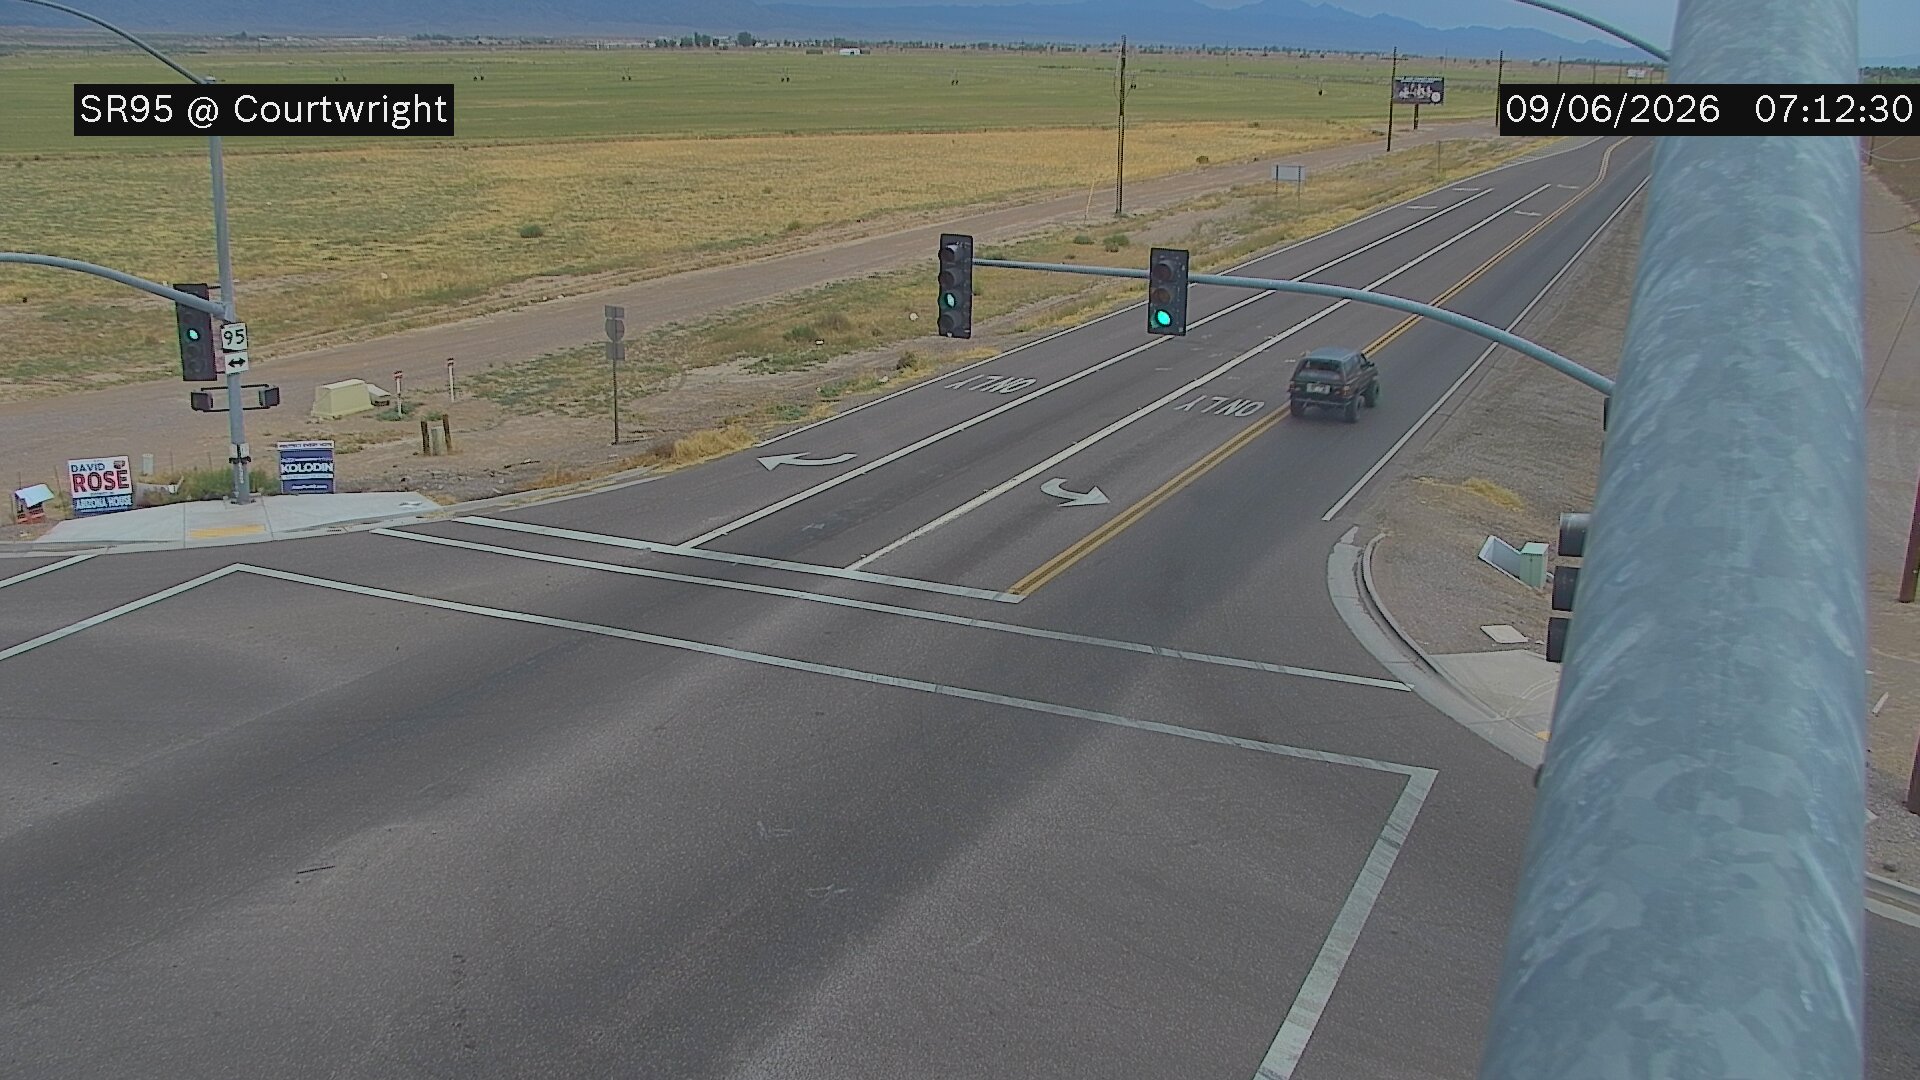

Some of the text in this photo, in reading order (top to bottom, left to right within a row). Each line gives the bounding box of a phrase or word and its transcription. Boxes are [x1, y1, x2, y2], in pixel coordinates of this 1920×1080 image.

[223, 328, 245, 346] 95
[944, 374, 1036, 394] ONLY
[1173, 395, 1265, 417] ONLY
[70, 463, 105, 473] DAVID
[280, 462, 333, 474] KOLODIN
[72, 470, 129, 492] ROSE
